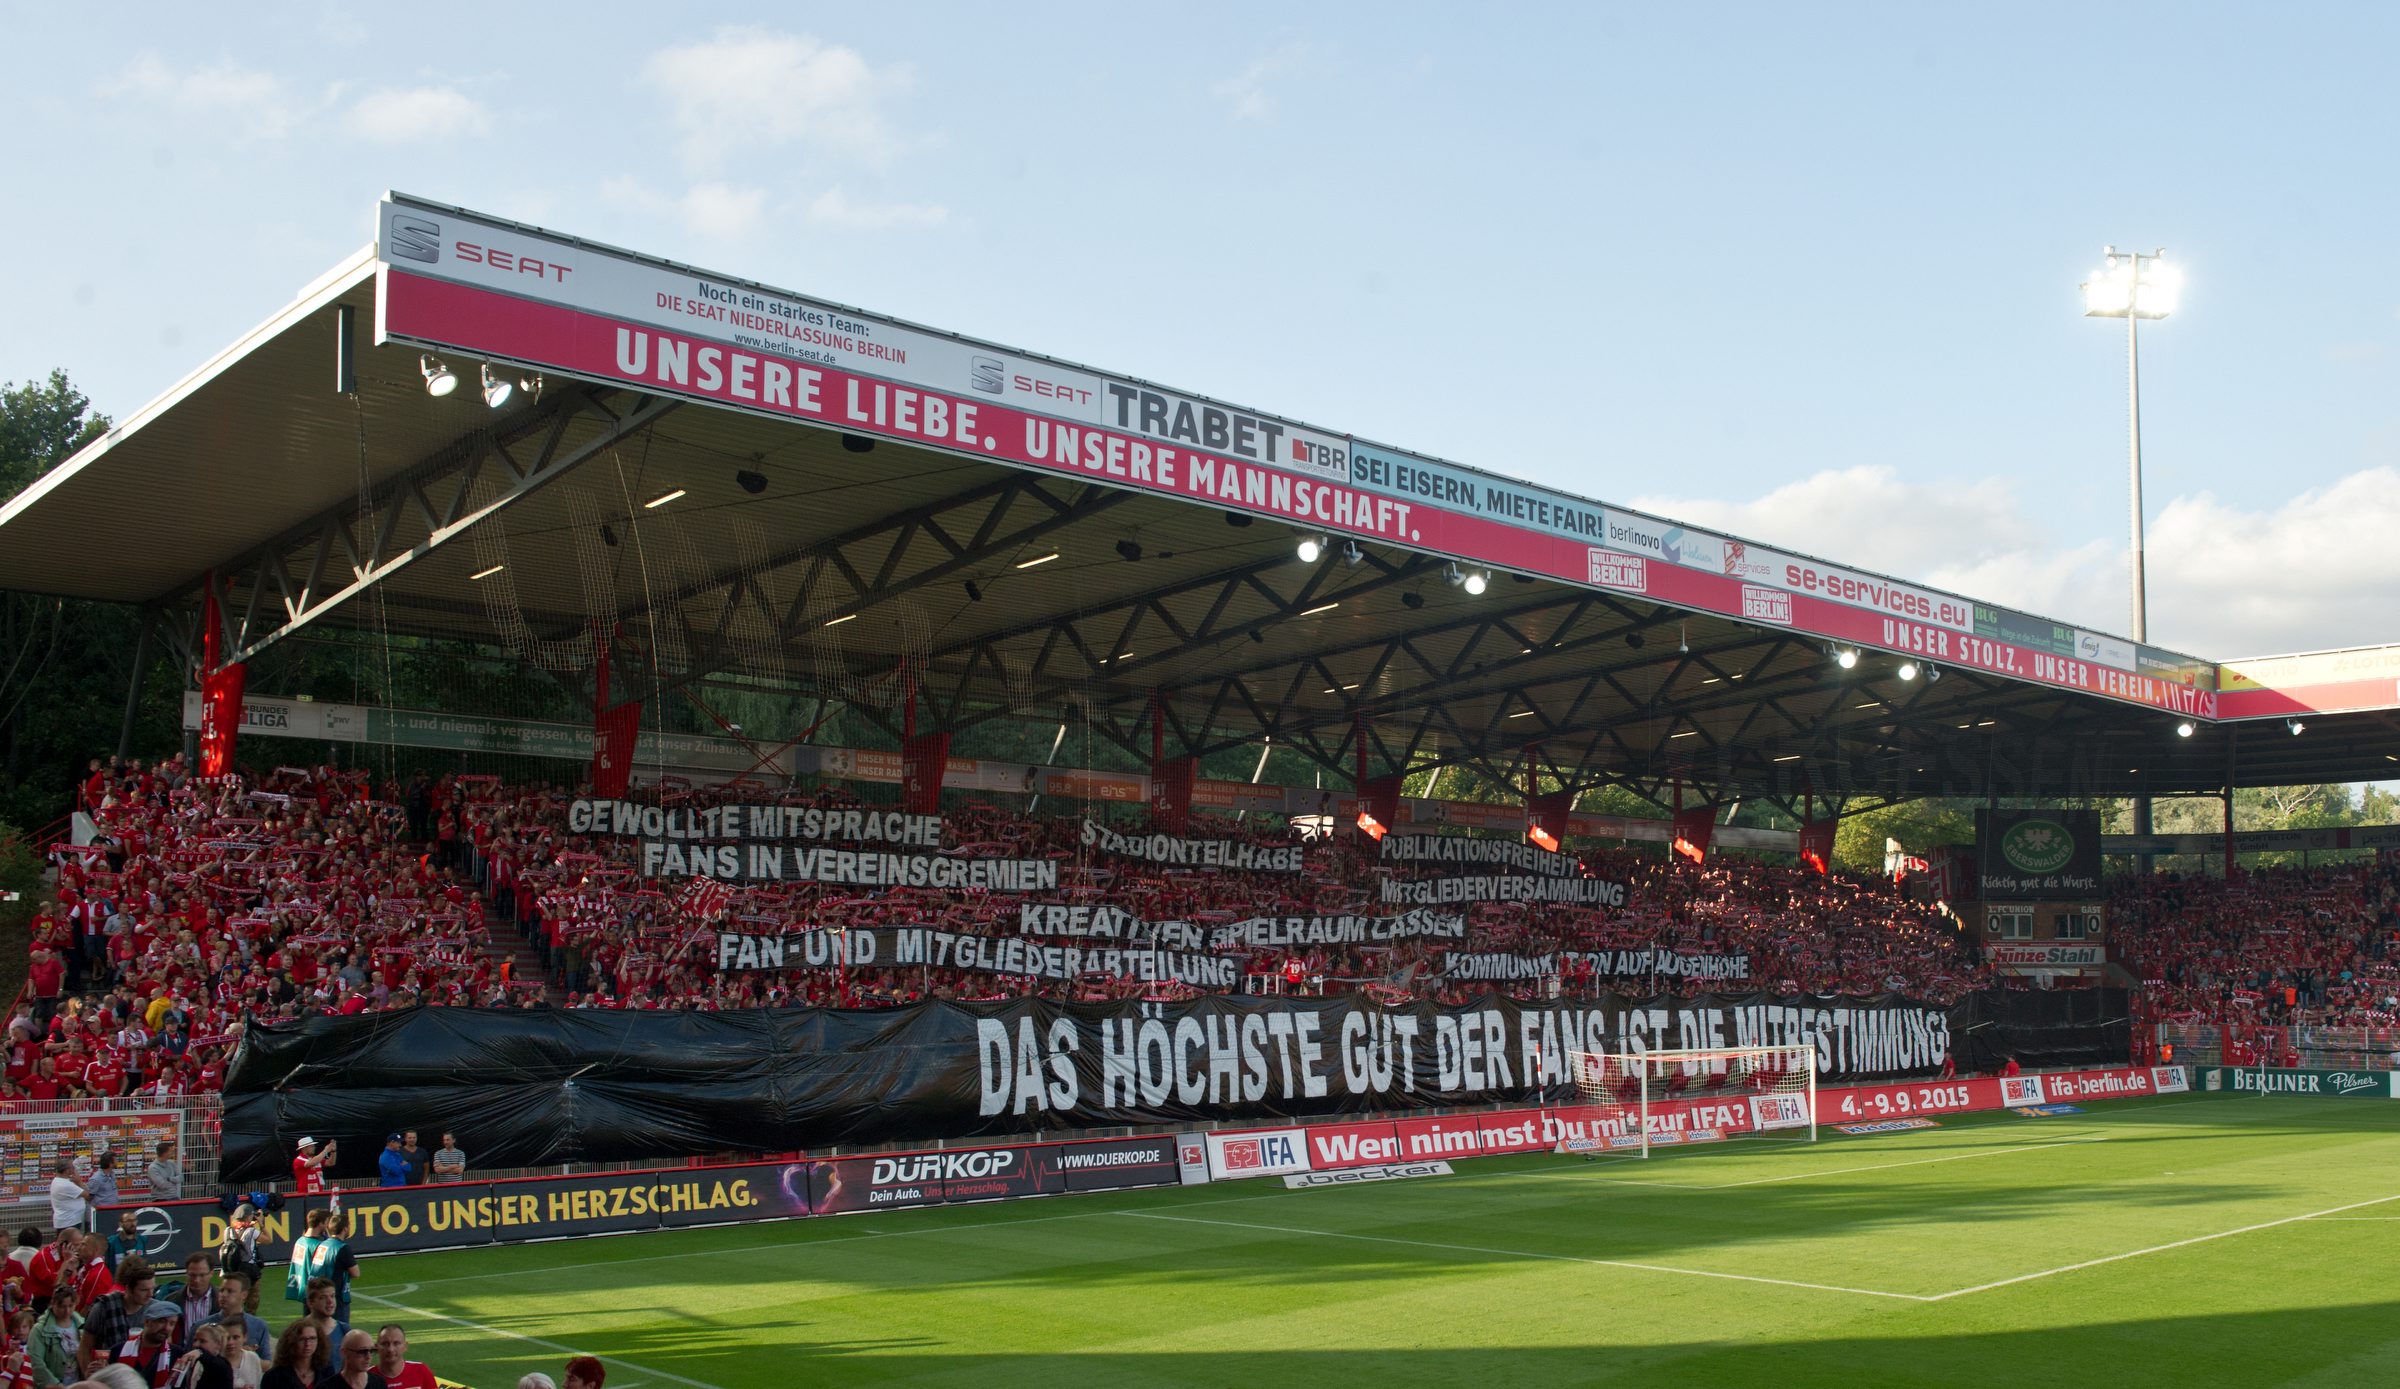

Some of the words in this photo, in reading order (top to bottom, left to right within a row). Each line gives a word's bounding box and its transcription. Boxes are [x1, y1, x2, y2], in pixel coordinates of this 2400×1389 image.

[455, 240, 572, 283] SEAT
[698, 282, 737, 306] Noch
[741, 293, 764, 310] ein
[768, 301, 824, 326] starkes
[828, 313, 870, 337] Team:
[656, 291, 683, 311] DIE
[686, 297, 726, 322] SEAT
[730, 309, 854, 353] NIEDERLASSUNG
[857, 339, 907, 364] BERLIN
[734, 332, 836, 366] www.berlin-seat.de
[1014, 375, 1092, 405] SEAT
[616, 327, 823, 414] UNSERE
[847, 379, 996, 451] LIEBE.
[1025, 418, 1175, 487] UNSERE
[1189, 455, 1420, 542] MANNSCHAFT.
[1109, 383, 1284, 463] TRABET
[1304, 440, 1346, 472] TBR
[1354, 455, 1390, 487] SEI
[1397, 465, 1482, 512] EISERN,
[1487, 488, 1550, 526] MIETE
[1554, 505, 1604, 538] FAIR!
[1610, 522, 1660, 550] berlinovo
[1592, 551, 1643, 568] WILLKOMMEN
[1737, 561, 1771, 575] services
[1592, 566, 1644, 589] BERLIN!
[1745, 588, 1788, 603] WILLKOMMEN
[1786, 564, 1966, 627] se-services.eu
[1745, 600, 1789, 621] BERLIN!
[1974, 606, 1998, 625] BUG
[2053, 625, 2074, 642] BUG
[1884, 619, 1948, 656] UNSER
[1960, 637, 2023, 675] STOLZ.
[2035, 654, 2088, 687] UNSER
[2098, 668, 2160, 704] VEREIN.
[249, 704, 289, 715] BUNDES
[249, 713, 289, 728] LIGA
[408, 716, 437, 730] und
[441, 719, 497, 735] niemals
[500, 724, 573, 744] vergessen,
[637, 734, 653, 748] ist
[657, 739, 692, 752] unser
[857, 753, 883, 764] UNSER
[857, 765, 883, 776] UNSER
[1048, 782, 1072, 793] 95.8
[569, 800, 742, 838] GEWOLLTE
[749, 805, 942, 847] MITSPRACHE
[1081, 819, 1303, 871] STADIONTEILHABE
[2210, 834, 2300, 843] TRASPORTBETON
[643, 843, 739, 878] FANS
[749, 845, 783, 880] IN
[794, 847, 1058, 891] VEREINSGREMIEN
[1380, 834, 1579, 877] PUBLIKATIONSFREIHEIT
[2006, 844, 2071, 868] EBERSWALDER
[1380, 875, 1625, 908] MITGLIEDERVERSAMMLUNG
[1982, 875, 2017, 893] Richtig
[2020, 877, 2040, 893] gut
[2043, 876, 2058, 889] die
[2062, 874, 2097, 891] Wurst.
[2007, 905, 2034, 913] UNION
[2081, 905, 2102, 914] GAST
[1021, 903, 1203, 950] KREATIVEN
[1209, 915, 1367, 948] SPIELRAUM
[1371, 908, 1465, 940] LASSEN
[1989, 915, 1999, 931] 0
[2089, 916, 2099, 932] 0
[896, 928, 1237, 987] MITGLIEDERABTEILUNG
[1288, 961, 1301, 974] 19
[1616, 950, 1652, 977] AUF
[1654, 950, 1750, 979] AUGENHÖHE
[977, 1016, 1079, 1116] DAS
[1101, 1002, 1329, 1108] HÖCHSTE
[1341, 1010, 1420, 1094] GUT
[1436, 1009, 1514, 1092] DER
[1520, 1009, 1606, 1089] FANS
[1617, 1009, 1669, 1080] IST
[1679, 1008, 1727, 1077] DIE
[1736, 1004, 1951, 1076] MITBESTIMMUNG!
[2021, 1078, 2038, 1099] IFA
[2050, 1071, 2147, 1097] ifa-berlin.de
[2169, 1068, 2182, 1086] IFA
[2234, 1068, 2321, 1093] BERLINER
[2327, 1072, 2378, 1094] Pilsner
[1780, 1097, 1800, 1121] IFA
[1919, 1086, 1970, 1109] 2015
[31, 1133, 69, 1141] kfzteile24
[83, 1130, 121, 1138] kfzteile24
[134, 1127, 171, 1136] kfzteile24
[1315, 1132, 1402, 1164] Wen
[1411, 1120, 1536, 1154] nimmst
[1543, 1117, 1585, 1143] Du
[1591, 1110, 1638, 1138] mit
[1646, 1112, 1688, 1133] zur
[1691, 1104, 1745, 1130] IFA?
[1650, 1131, 1681, 1144] kfzteile24
[1688, 1129, 1718, 1141] kfzteile24
[1843, 1119, 1932, 1135] kfzteile24
[1260, 1136, 1295, 1167] IFA
[1565, 1137, 1602, 1150] kfzteile24
[872, 1151, 1013, 1185] DÜRKOP
[1056, 1149, 1160, 1170] WWW.DUERKOP.DE
[1306, 1162, 1440, 1185] becker
[869, 1189, 893, 1203] Dein
[894, 1187, 922, 1201] Auto.
[924, 1184, 954, 1198] Unser
[956, 1181, 1010, 1196] Herzschlag.
[202, 1210, 290, 1249] DN
[429, 1190, 540, 1231] UNSER
[548, 1178, 758, 1224] HERZSCHLAG.
